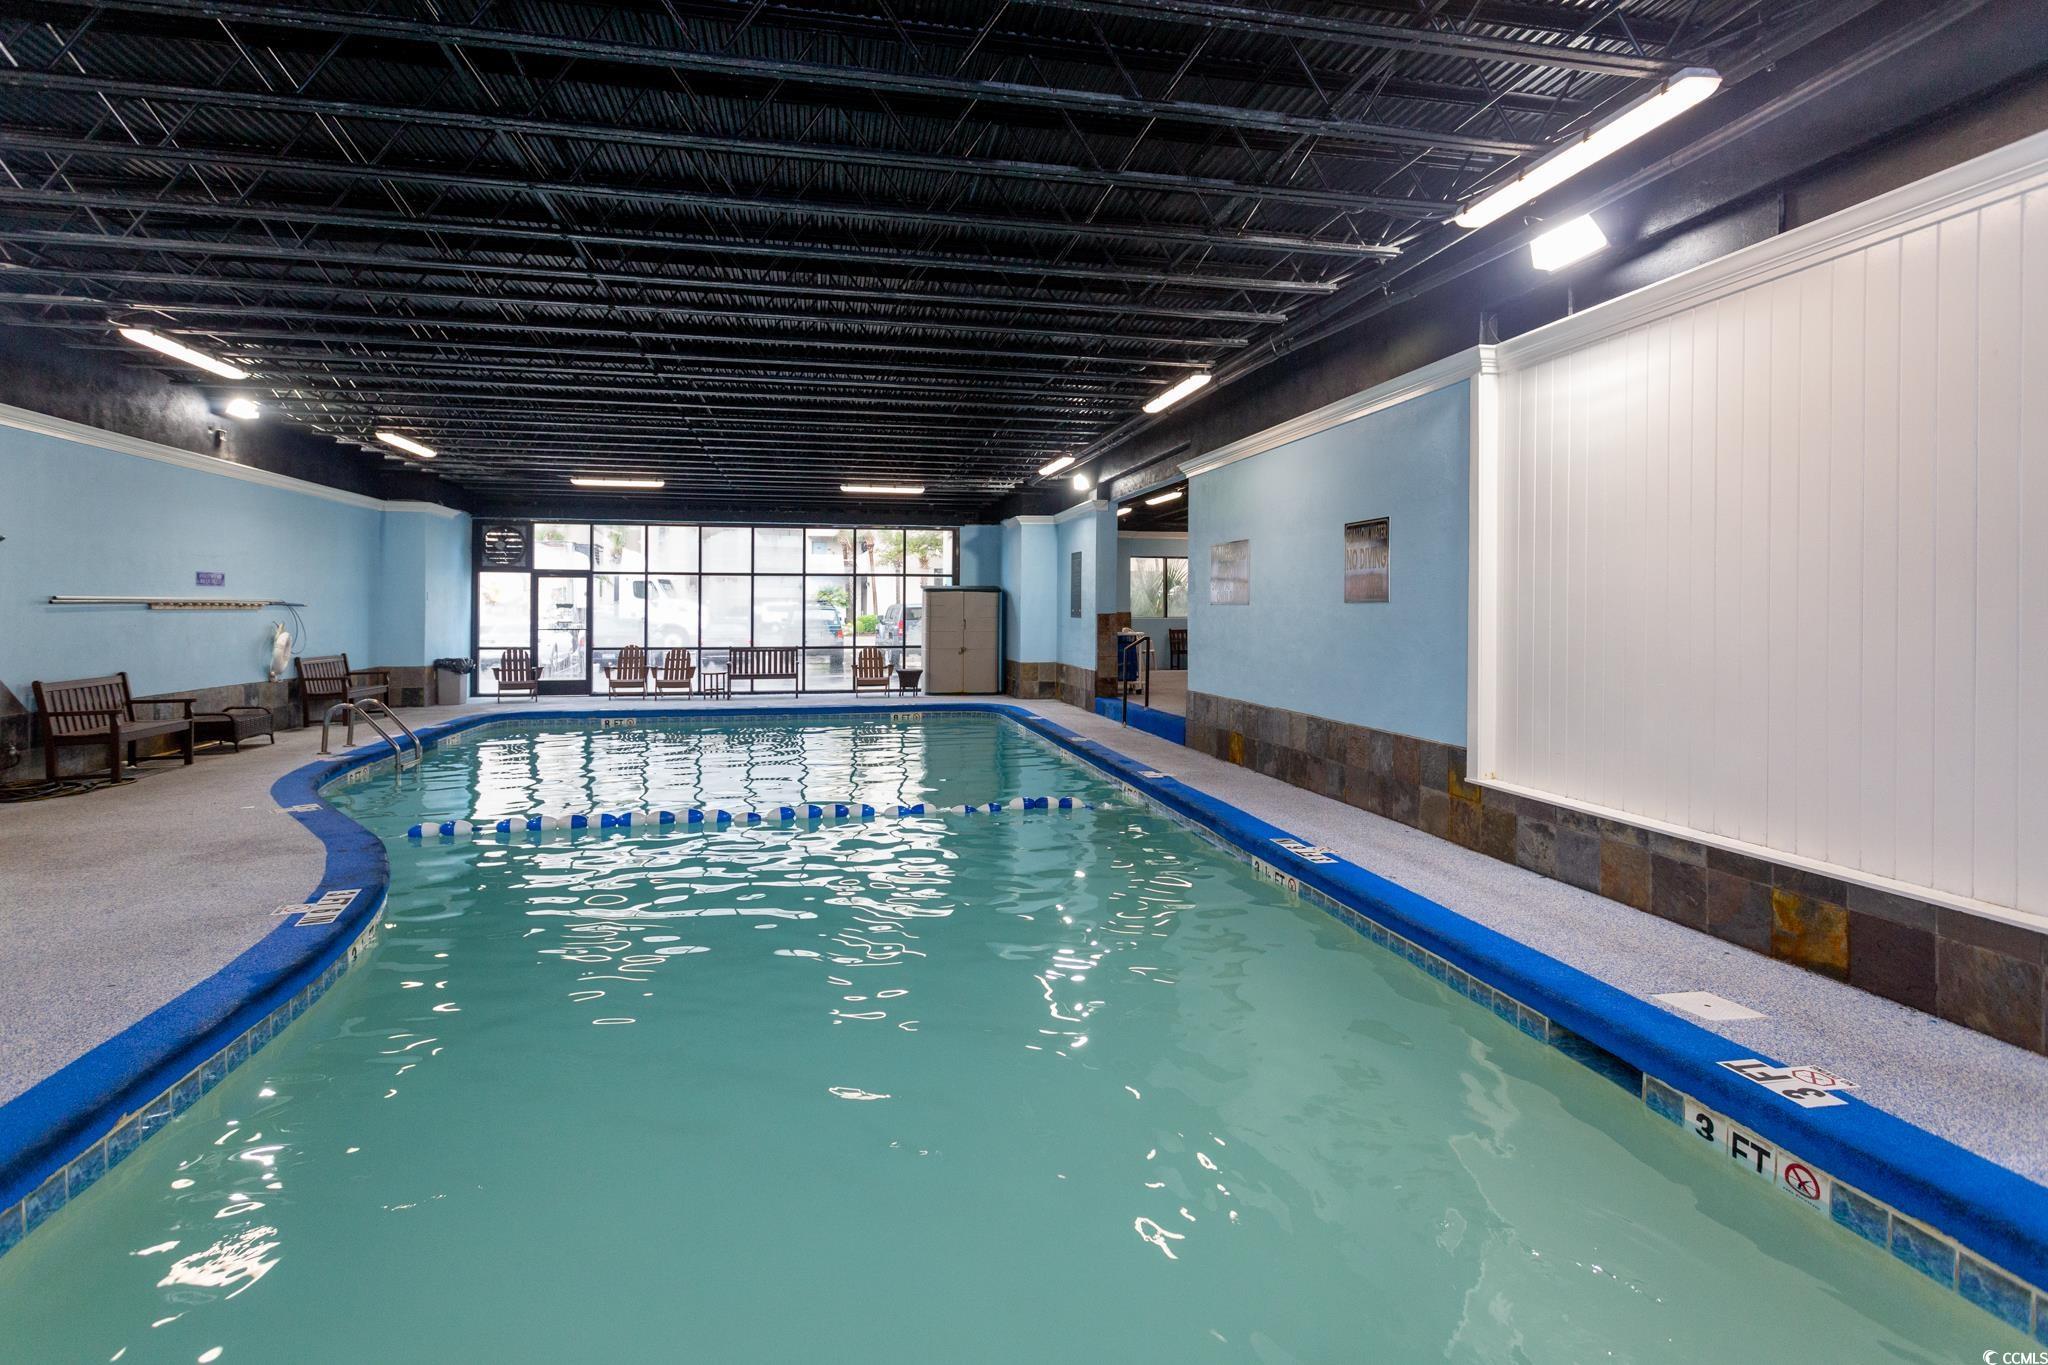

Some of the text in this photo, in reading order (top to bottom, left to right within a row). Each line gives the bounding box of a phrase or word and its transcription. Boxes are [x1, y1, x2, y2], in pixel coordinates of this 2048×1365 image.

[1346, 546, 1387, 570] NO DIVING
[1722, 1063, 1793, 1082] FT
[1782, 1087, 1826, 1099] 3
[1695, 1113, 1772, 1174] 3 FT
